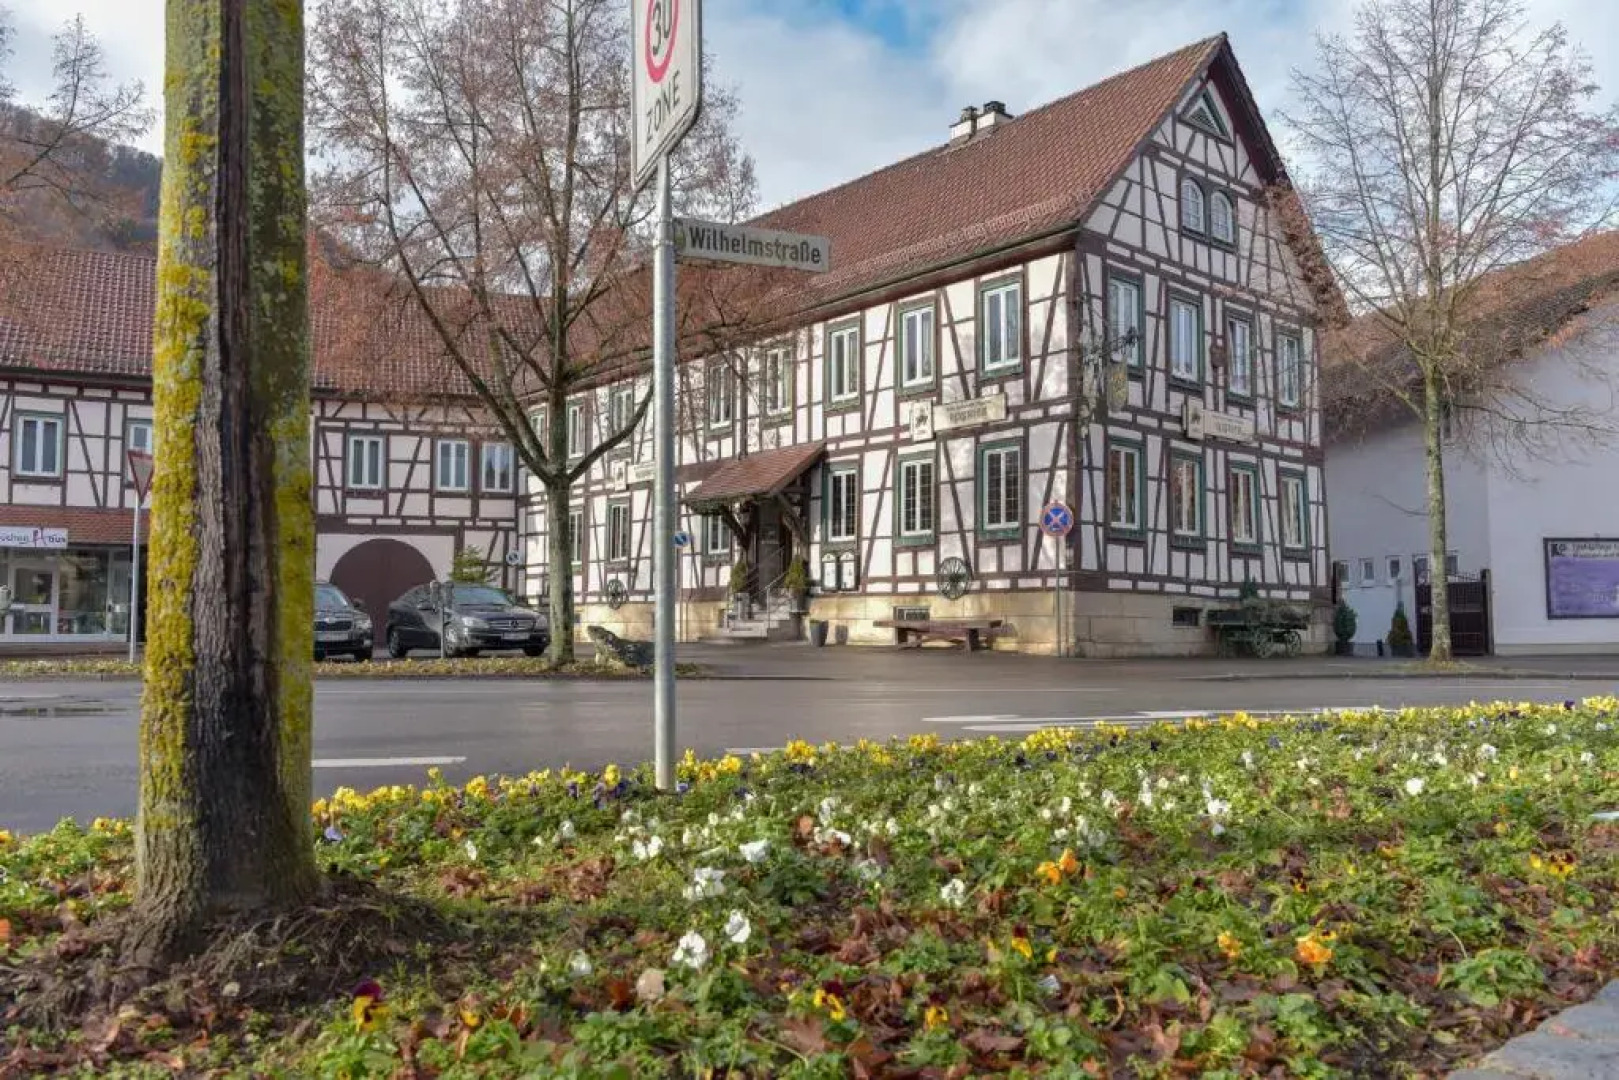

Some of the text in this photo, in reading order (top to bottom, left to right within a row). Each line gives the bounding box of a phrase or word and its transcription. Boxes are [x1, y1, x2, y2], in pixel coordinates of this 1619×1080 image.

[652, 0, 672, 56] 30
[646, 69, 680, 144] ZONE
[689, 226, 821, 264] Wilhelmstraße
